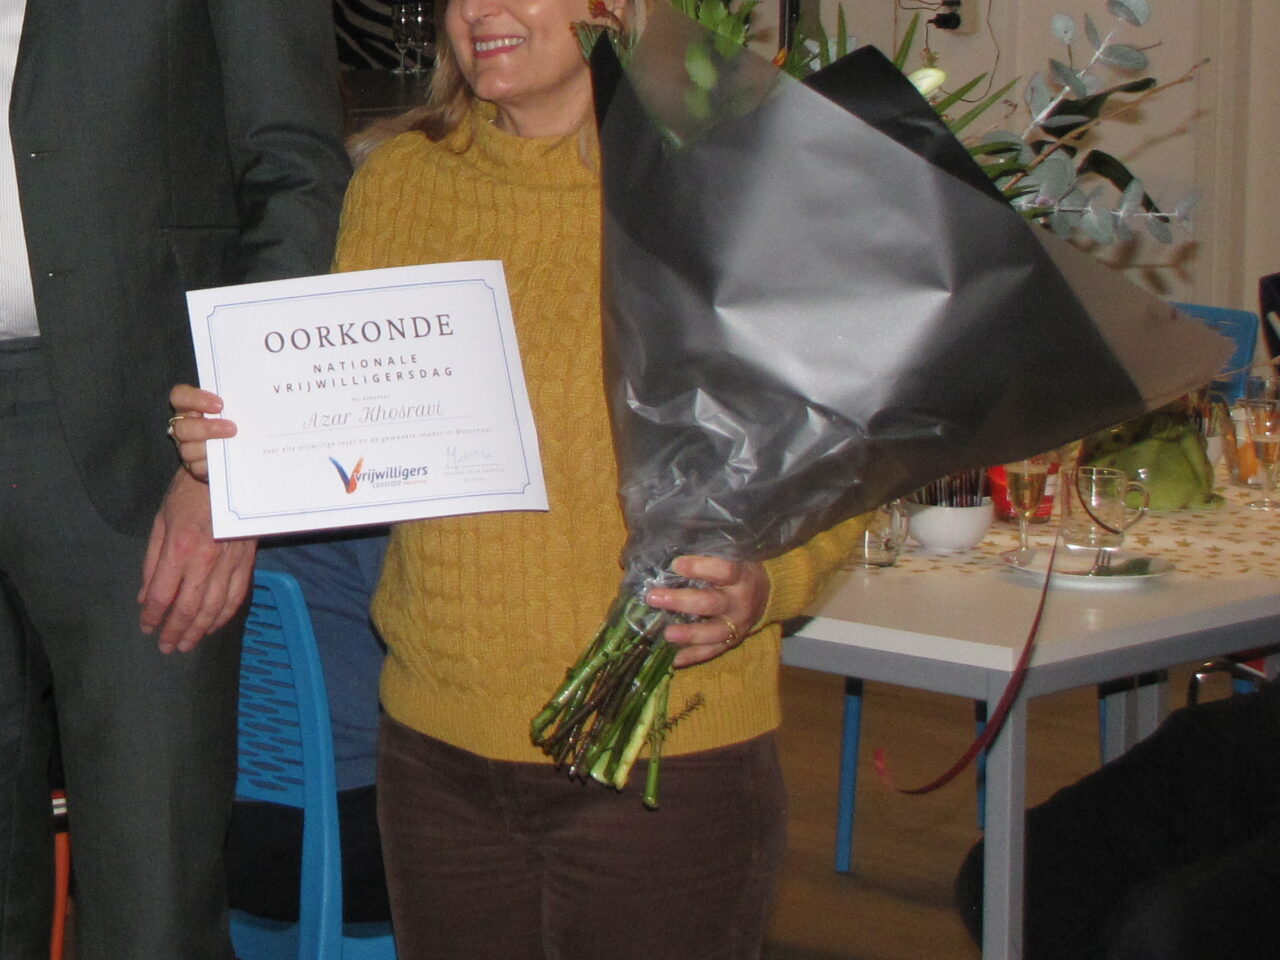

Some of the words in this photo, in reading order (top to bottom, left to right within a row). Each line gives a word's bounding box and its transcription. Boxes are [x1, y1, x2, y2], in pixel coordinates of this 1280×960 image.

[263, 312, 455, 354] OORKONDE
[312, 353, 419, 374] NATIONALE
[272, 366, 455, 394] VRIJWILLIGERSDAG
[302, 411, 352, 430] Azar
[358, 400, 444, 424] Khosravi
[353, 464, 429, 484] vrijwilligers
